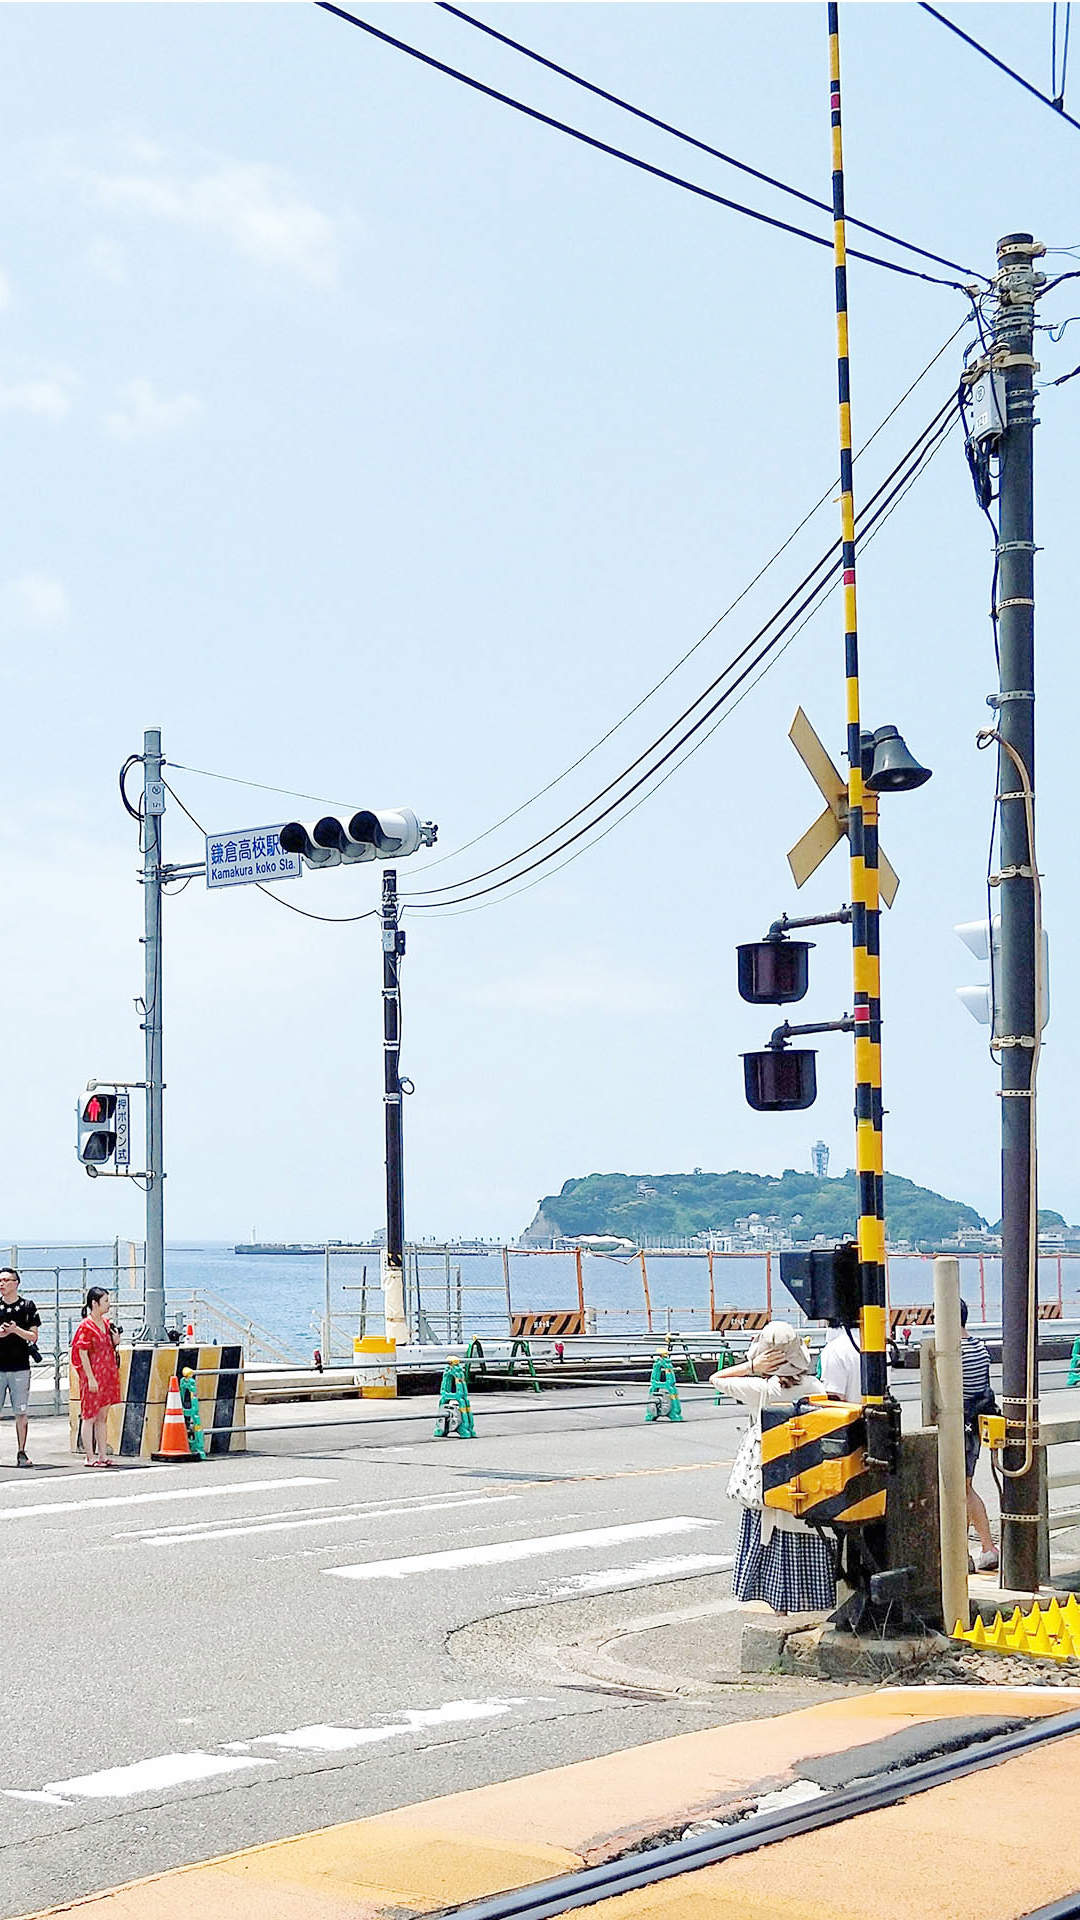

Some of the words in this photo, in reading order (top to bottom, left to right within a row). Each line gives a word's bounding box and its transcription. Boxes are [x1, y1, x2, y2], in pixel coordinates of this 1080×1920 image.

[211, 834, 289, 865] 鎌倉高校駅
[212, 865, 253, 880] Kamakura
[256, 861, 276, 874] koko
[117, 1098, 127, 1160] 押ボタン式
